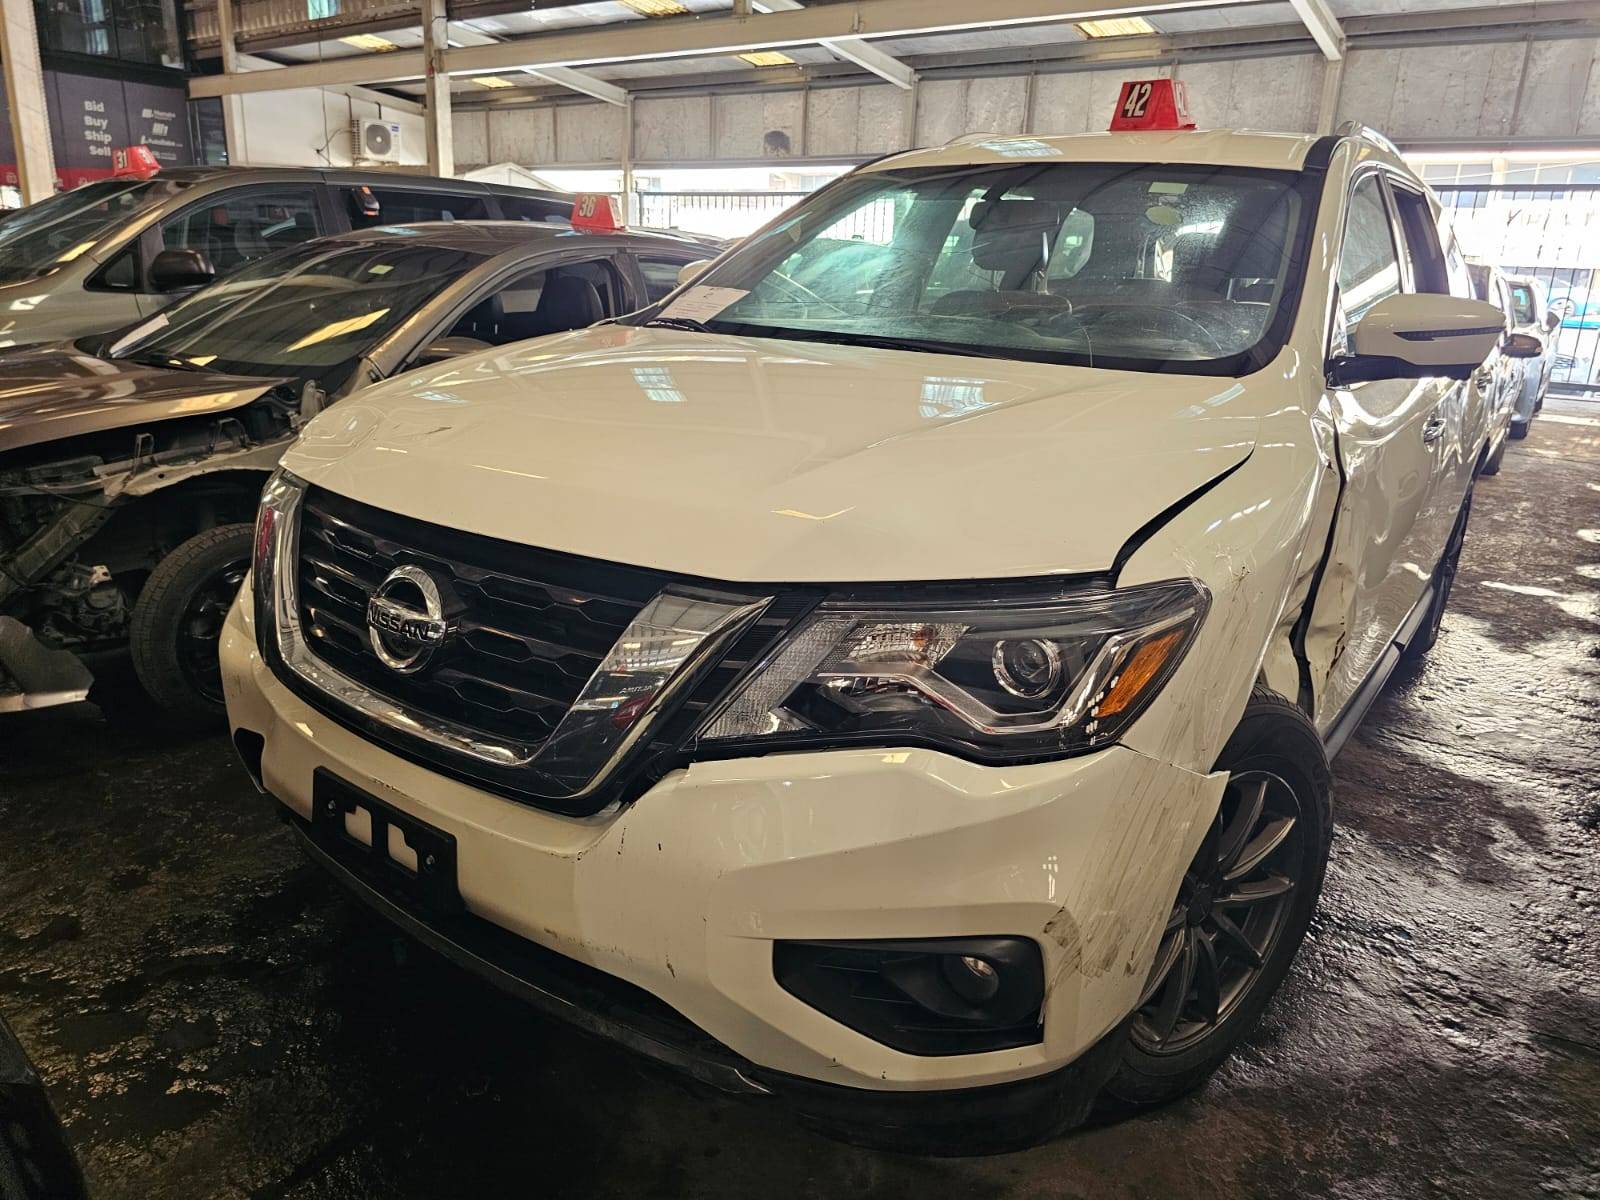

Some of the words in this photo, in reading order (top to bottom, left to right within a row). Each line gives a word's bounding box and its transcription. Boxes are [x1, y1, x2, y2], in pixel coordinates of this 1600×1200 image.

[84, 101, 105, 113] Bid
[1124, 83, 1152, 117] 42
[84, 116, 108, 129] Buy
[84, 131, 112, 145] Ship
[89, 146, 112, 157] Sell
[115, 151, 128, 170] 31
[578, 195, 596, 217] 36
[366, 602, 430, 642] NISSAN
